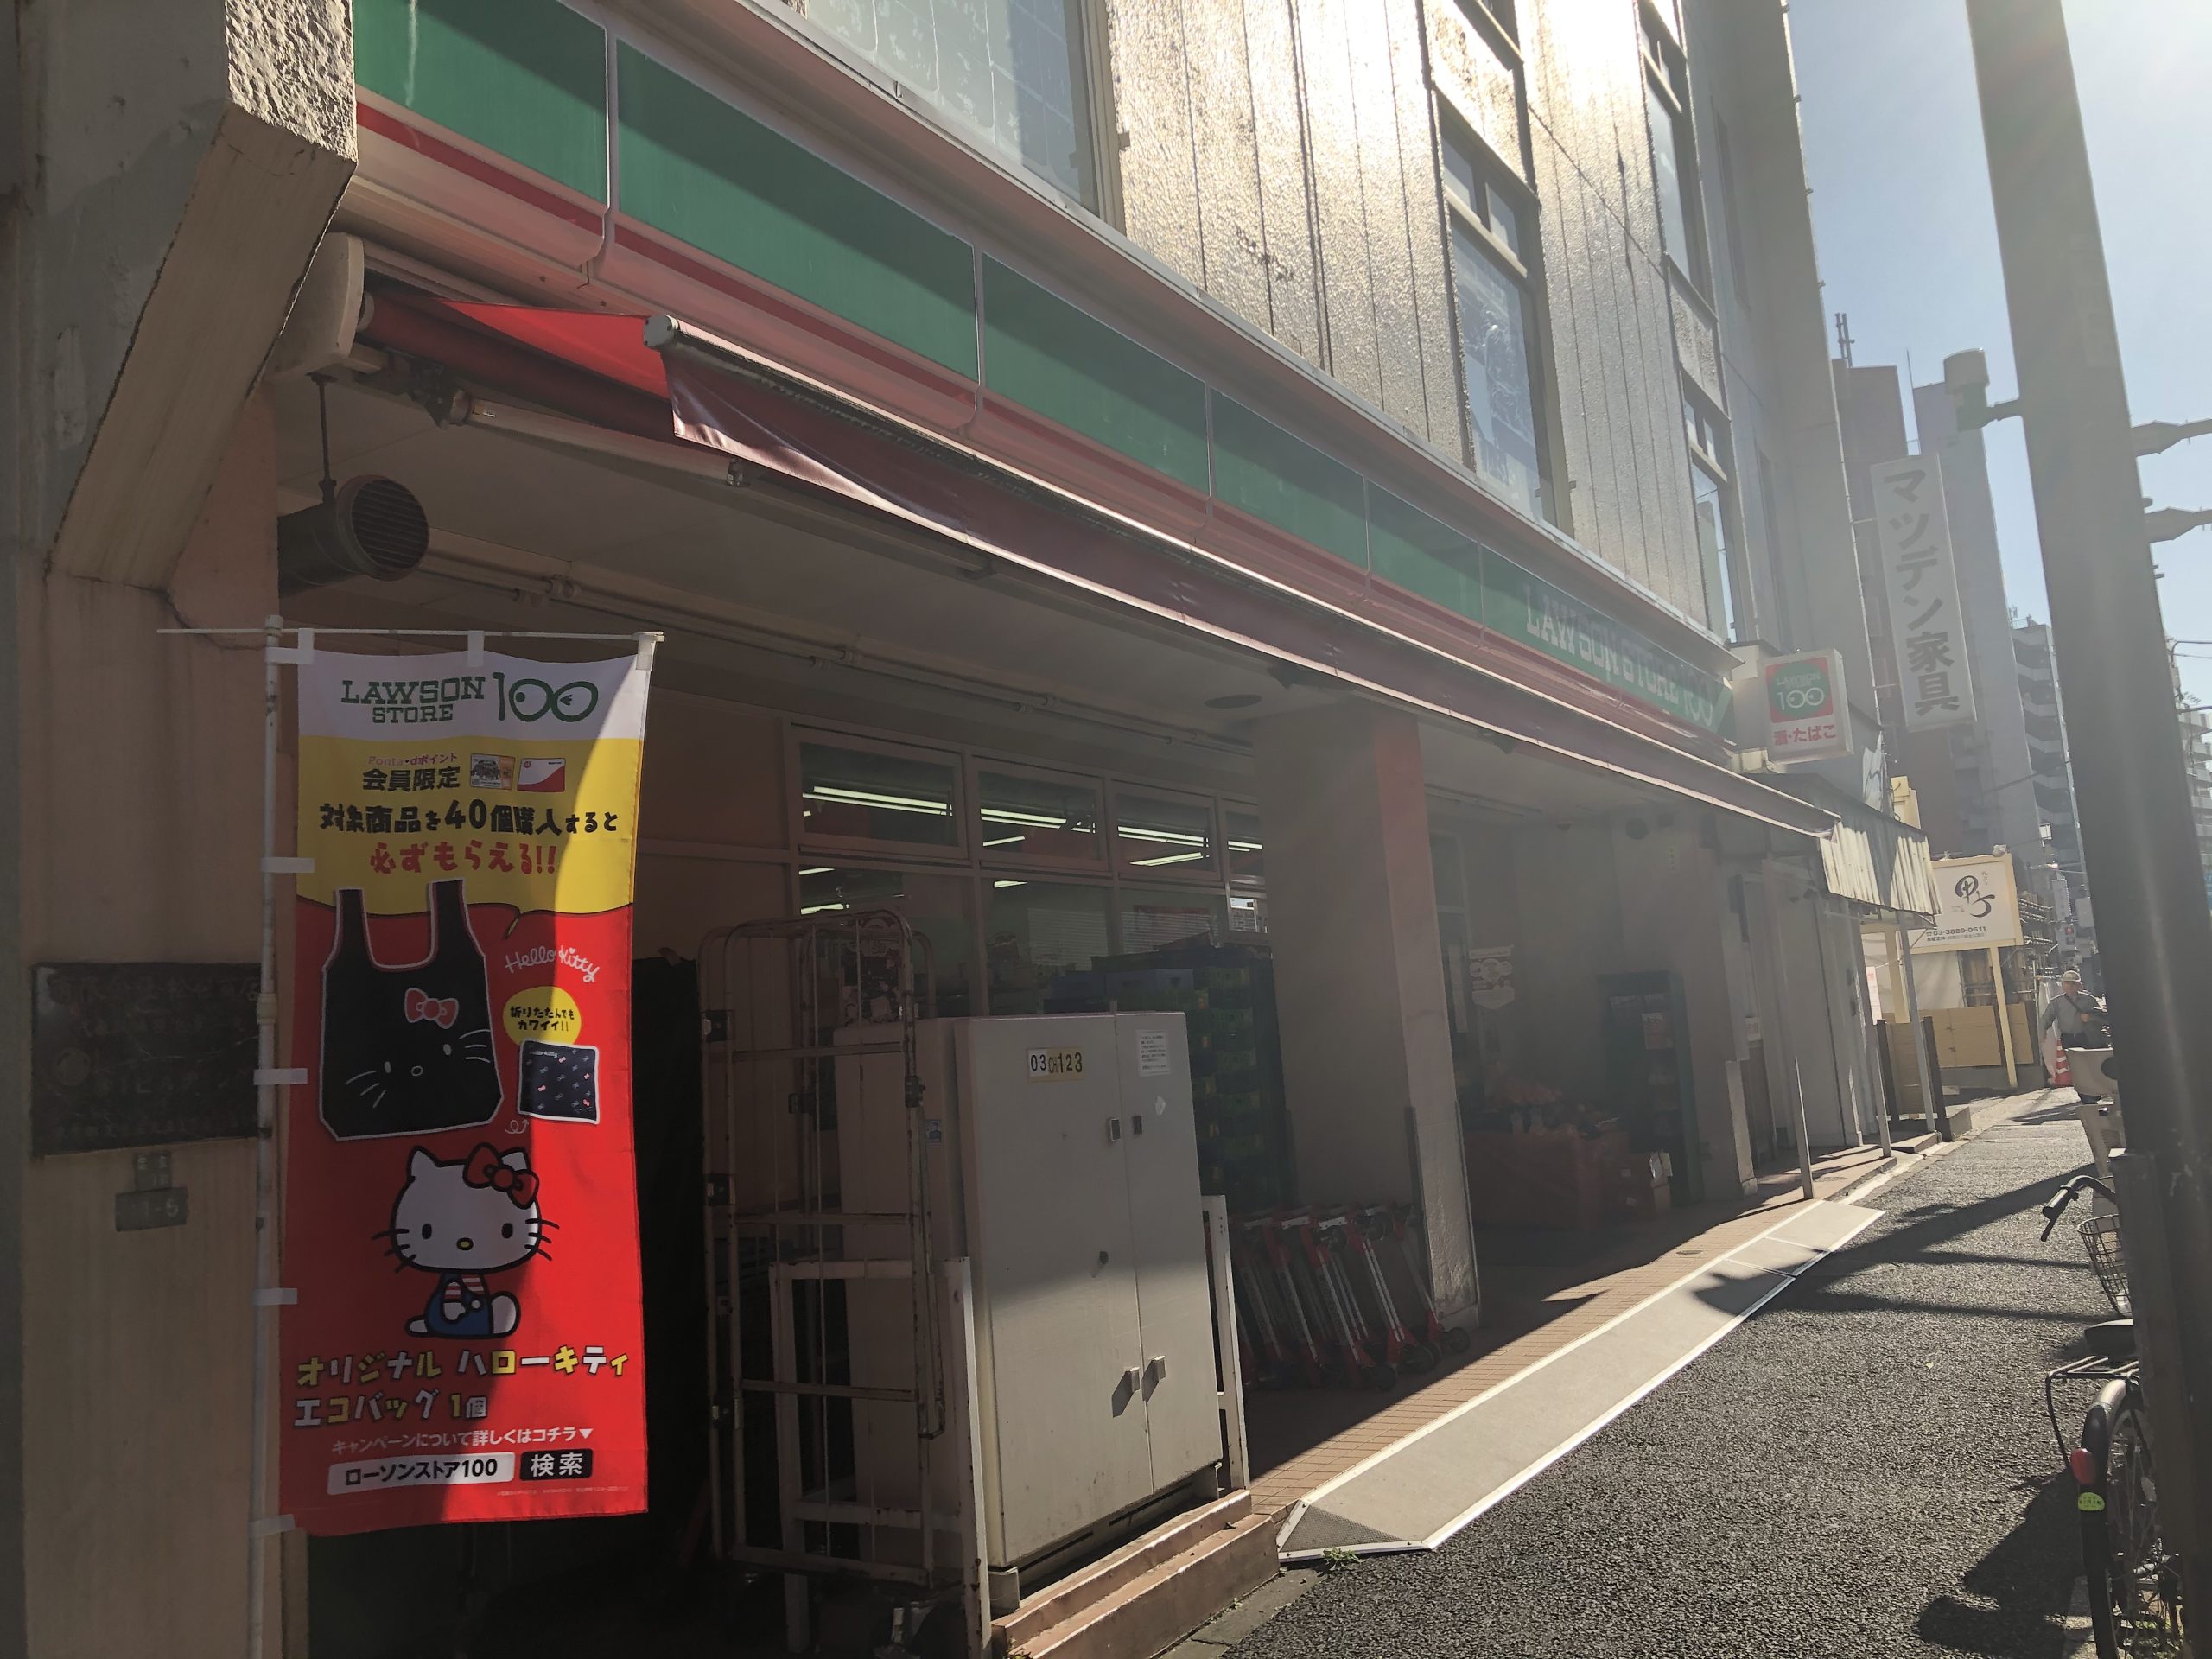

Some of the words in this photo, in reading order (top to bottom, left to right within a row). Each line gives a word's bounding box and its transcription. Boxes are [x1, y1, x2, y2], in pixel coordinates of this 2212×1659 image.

[1882, 469, 1960, 715] マツテン家具
[340, 676, 486, 704] LAWSON
[492, 671, 599, 722] 100
[1777, 687, 1825, 710] 100
[372, 703, 454, 724] STORE
[362, 766, 461, 792] 会員限定
[320, 799, 618, 836] 対象商品を40個購入すると
[505, 945, 556, 975] Hello
[557, 944, 601, 983] Kitty
[510, 1005, 575, 1021] 折りたたんでも
[296, 1349, 442, 1387] オリジナル
[457, 1344, 629, 1377] ハローキティ
[294, 1389, 439, 1427] エコバッグ
[449, 1394, 488, 1419] 1個
[346, 1459, 498, 1485] ローソンストア100
[531, 1452, 583, 1477] 検索
